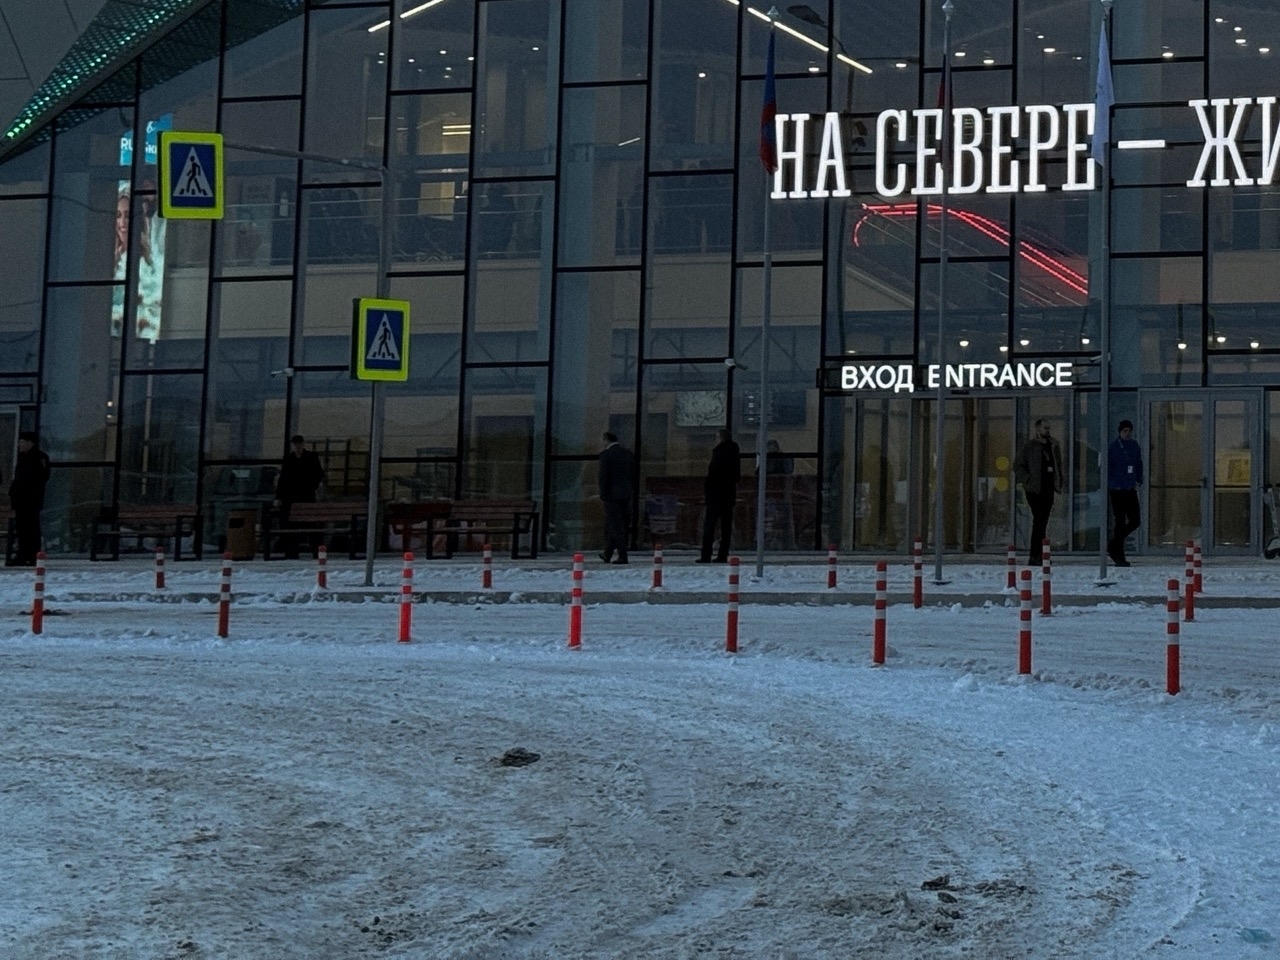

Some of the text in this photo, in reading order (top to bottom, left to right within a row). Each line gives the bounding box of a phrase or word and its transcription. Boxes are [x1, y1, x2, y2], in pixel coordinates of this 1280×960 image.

[771, 112, 851, 199] НА
[875, 103, 1096, 197] СЕВЕРЕ
[841, 364, 914, 393] ВХОД
[928, 362, 1073, 388] ENTRANCE
